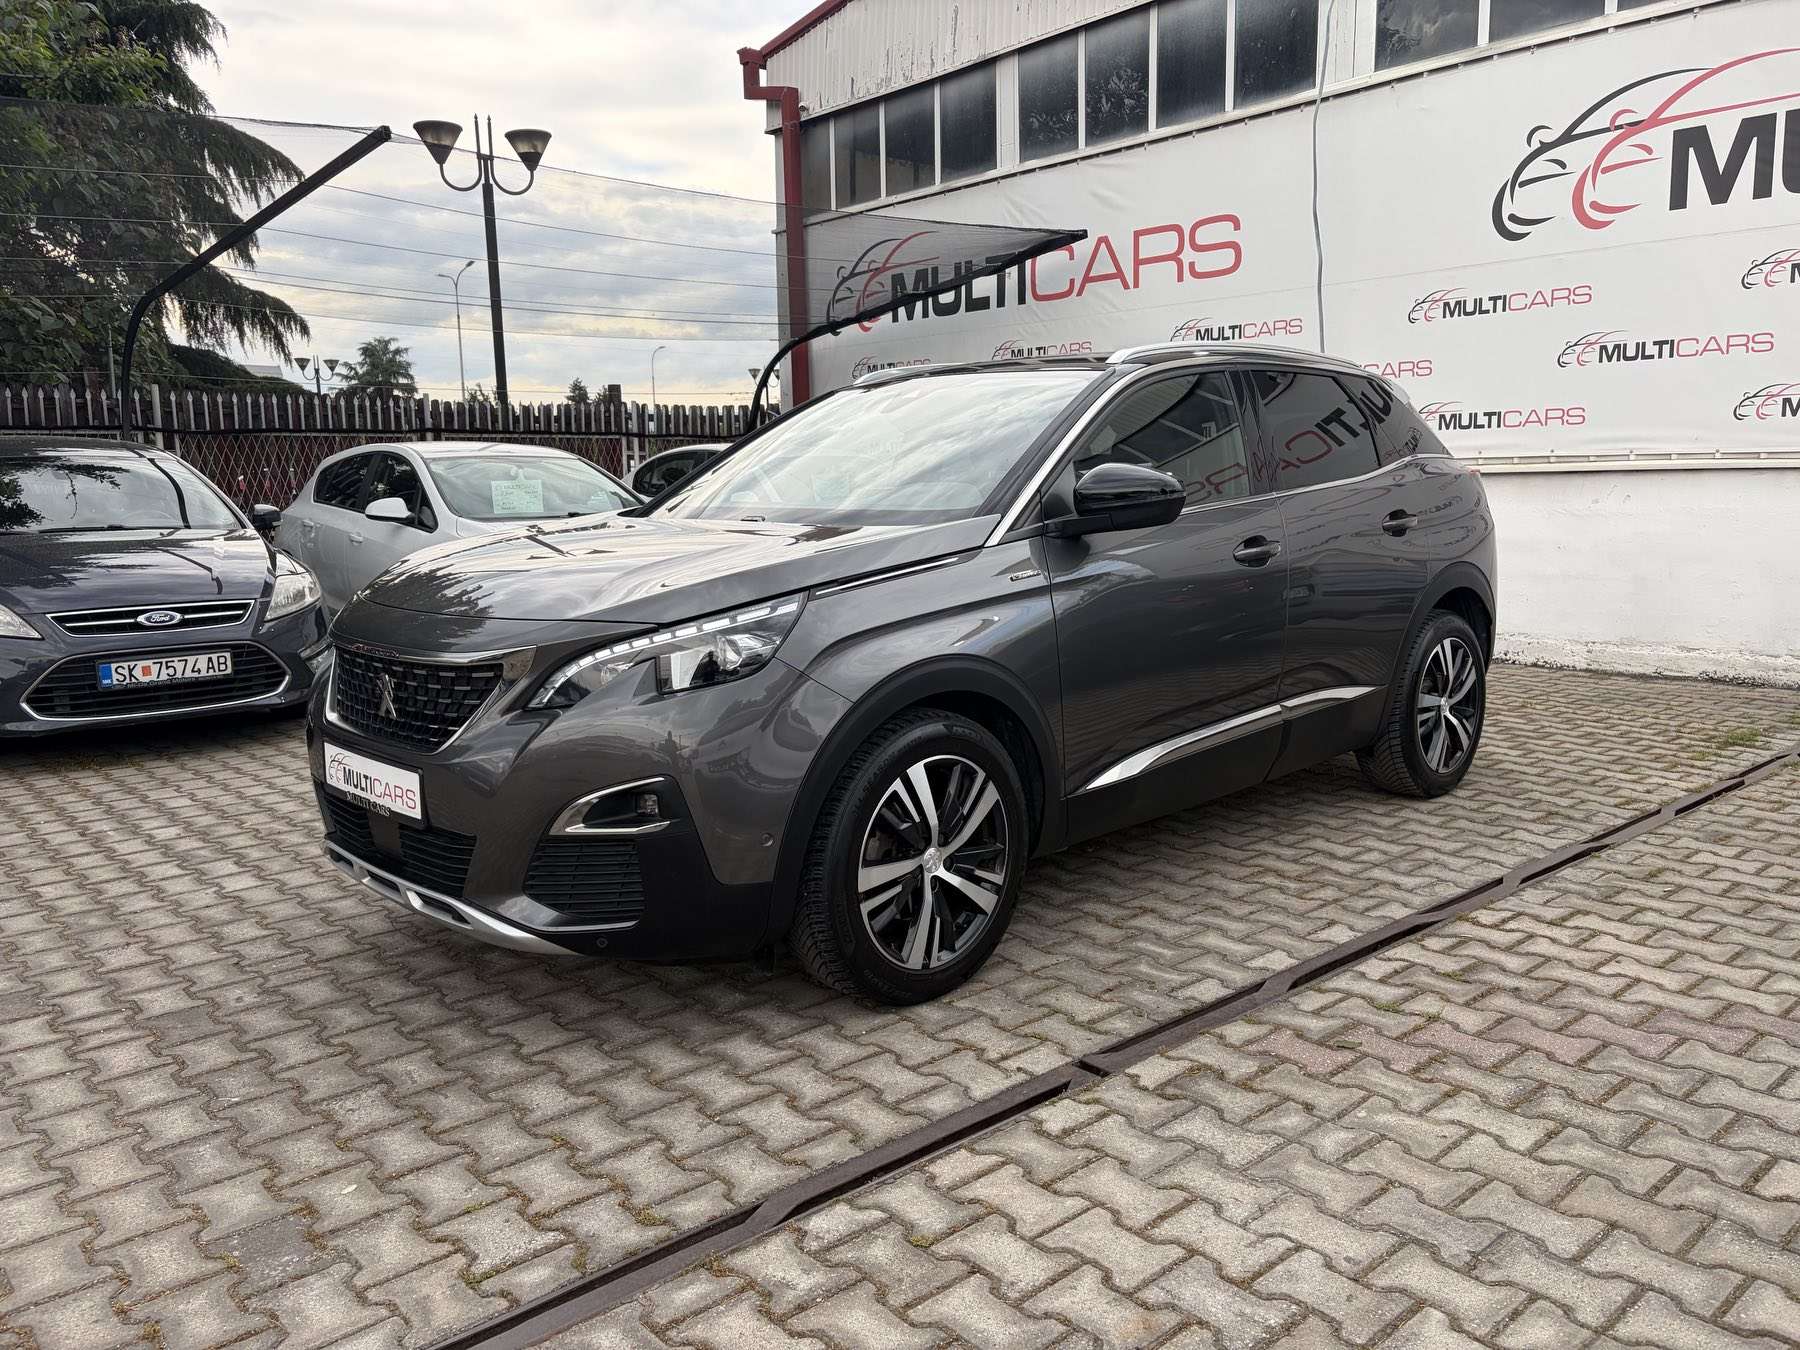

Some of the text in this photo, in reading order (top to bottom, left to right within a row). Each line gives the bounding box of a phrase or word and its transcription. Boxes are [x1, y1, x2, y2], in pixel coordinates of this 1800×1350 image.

[1669, 108, 1800, 211] M
[890, 214, 1242, 324] MULTICARS
[1441, 285, 1593, 320] MULTICARS
[1195, 318, 1304, 341] MULTICARS
[1597, 332, 1775, 364] MULTICARS
[1438, 407, 1586, 431] MULTICARS
[150, 613, 171, 622] Ford
[114, 655, 228, 683] SK 7574 AB
[342, 766, 417, 810] MULTICARS
